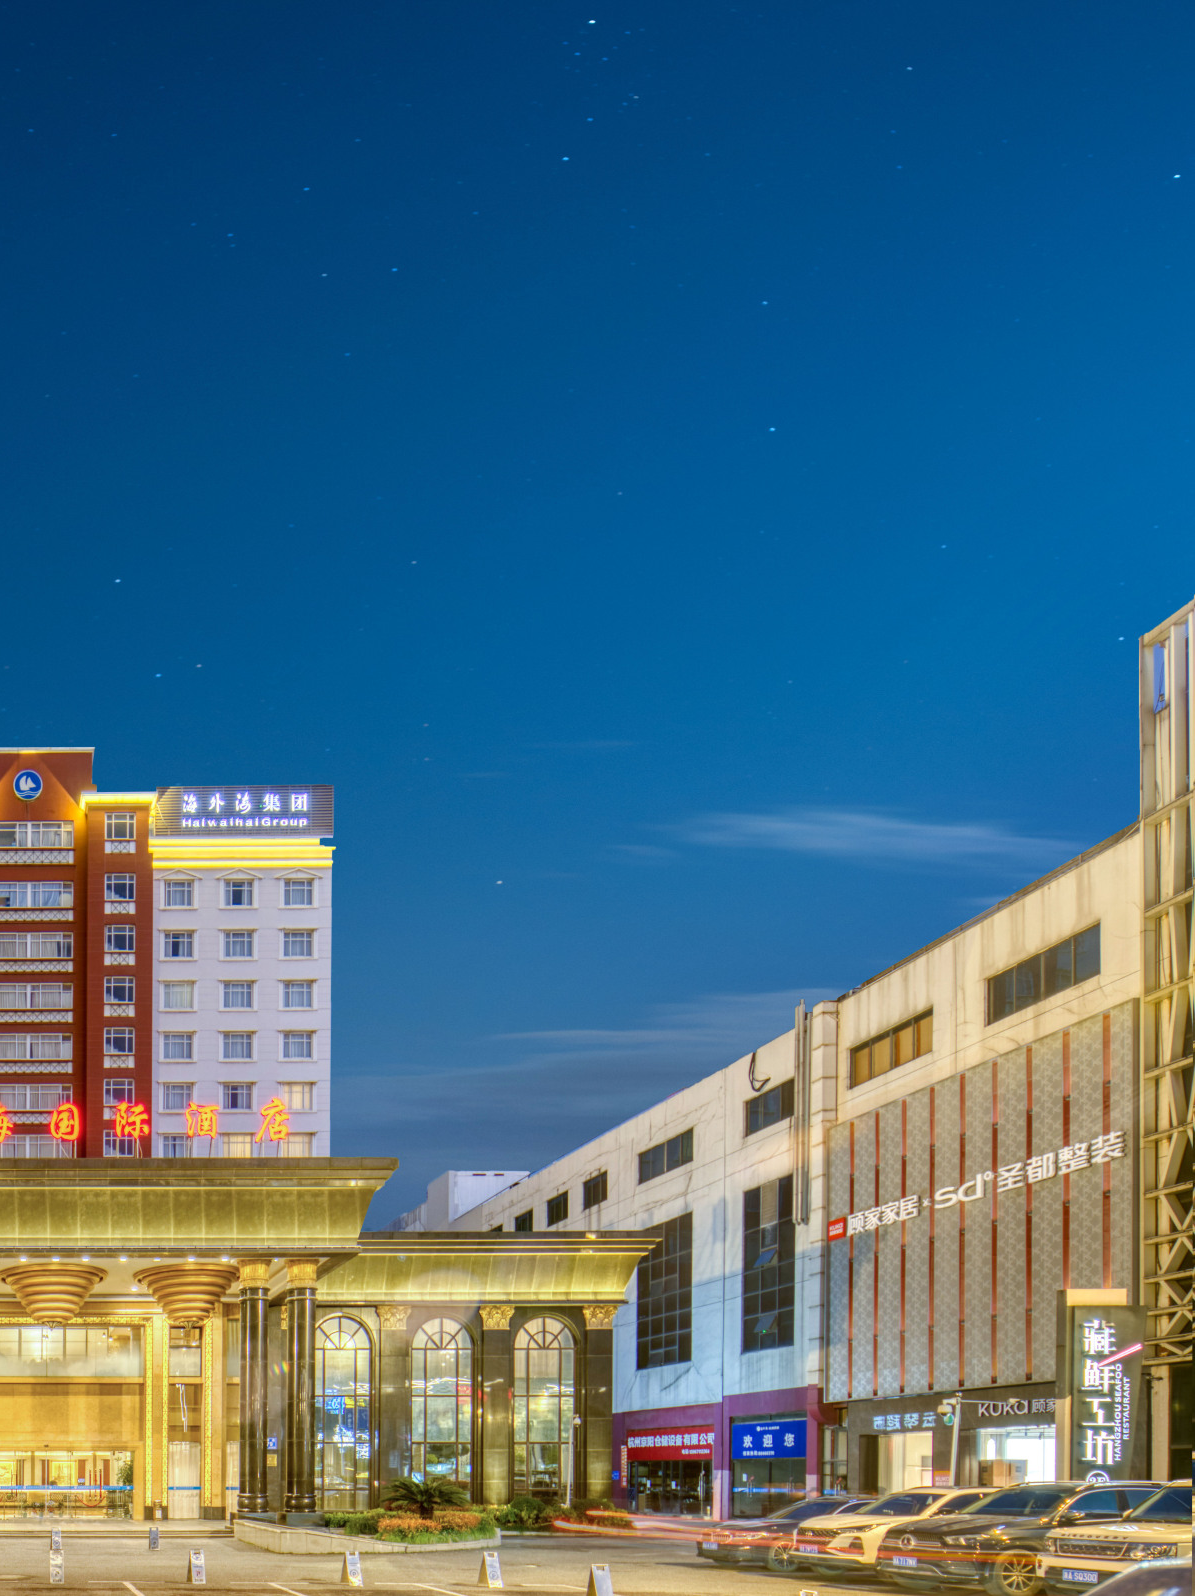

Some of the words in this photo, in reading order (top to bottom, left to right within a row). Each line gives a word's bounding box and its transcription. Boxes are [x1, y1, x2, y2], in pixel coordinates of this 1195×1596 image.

[182, 791, 308, 814] 海外海集团
[847, 1194, 922, 1236] 顾家家居
[996, 1131, 1127, 1193] 圣都整装
[1079, 1319, 1117, 1465] 藏鲜工坊
[1123, 1377, 1131, 1440] RESTAURANT
[742, 1433, 795, 1448] 欢迎您
[1114, 1405, 1122, 1461] HANGZHOU
[1061, 1532, 1129, 1540] DISCOVERY
